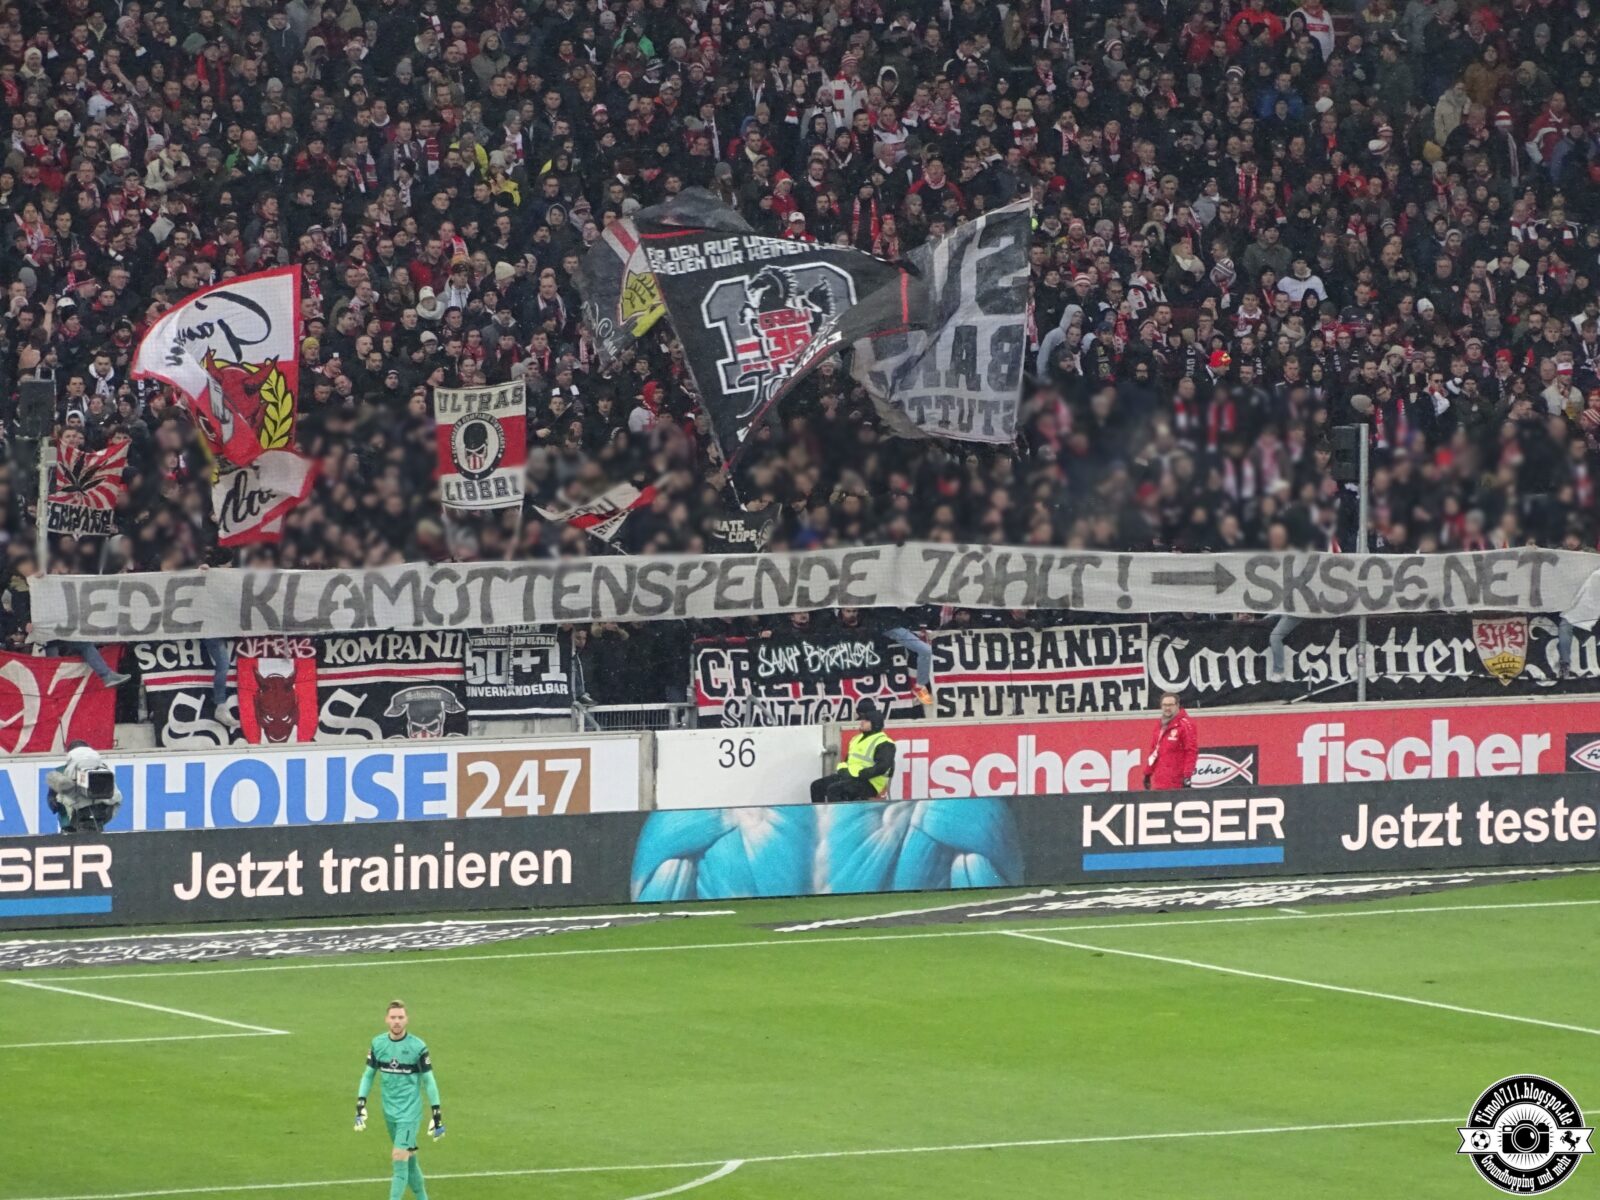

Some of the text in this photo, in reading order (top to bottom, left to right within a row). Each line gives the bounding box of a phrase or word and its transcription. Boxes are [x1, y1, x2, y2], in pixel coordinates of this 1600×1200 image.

[703, 237, 739, 256] RUF
[711, 250, 744, 269] WIR
[436, 384, 525, 414] ULTRAS
[728, 529, 757, 544] COPS
[53, 575, 207, 637] JEDE
[239, 549, 881, 633] KLAMOTTENSPENDE
[1242, 550, 1560, 614] SKS06.NET
[236, 637, 318, 659] ULTRAS
[464, 640, 569, 685] 50+1
[931, 625, 1144, 673] SÜDBANDE
[465, 682, 569, 698] UNVERHANDELBAR
[936, 678, 1146, 719] STUTTGART
[718, 738, 757, 770] 36
[892, 734, 1141, 801] fischer
[1298, 719, 1551, 785] fischer
[465, 757, 583, 817] 247
[1082, 797, 1286, 848] KIESER
[1341, 799, 1463, 851] Jetzt
[173, 841, 573, 901] Jetzt trainieren
